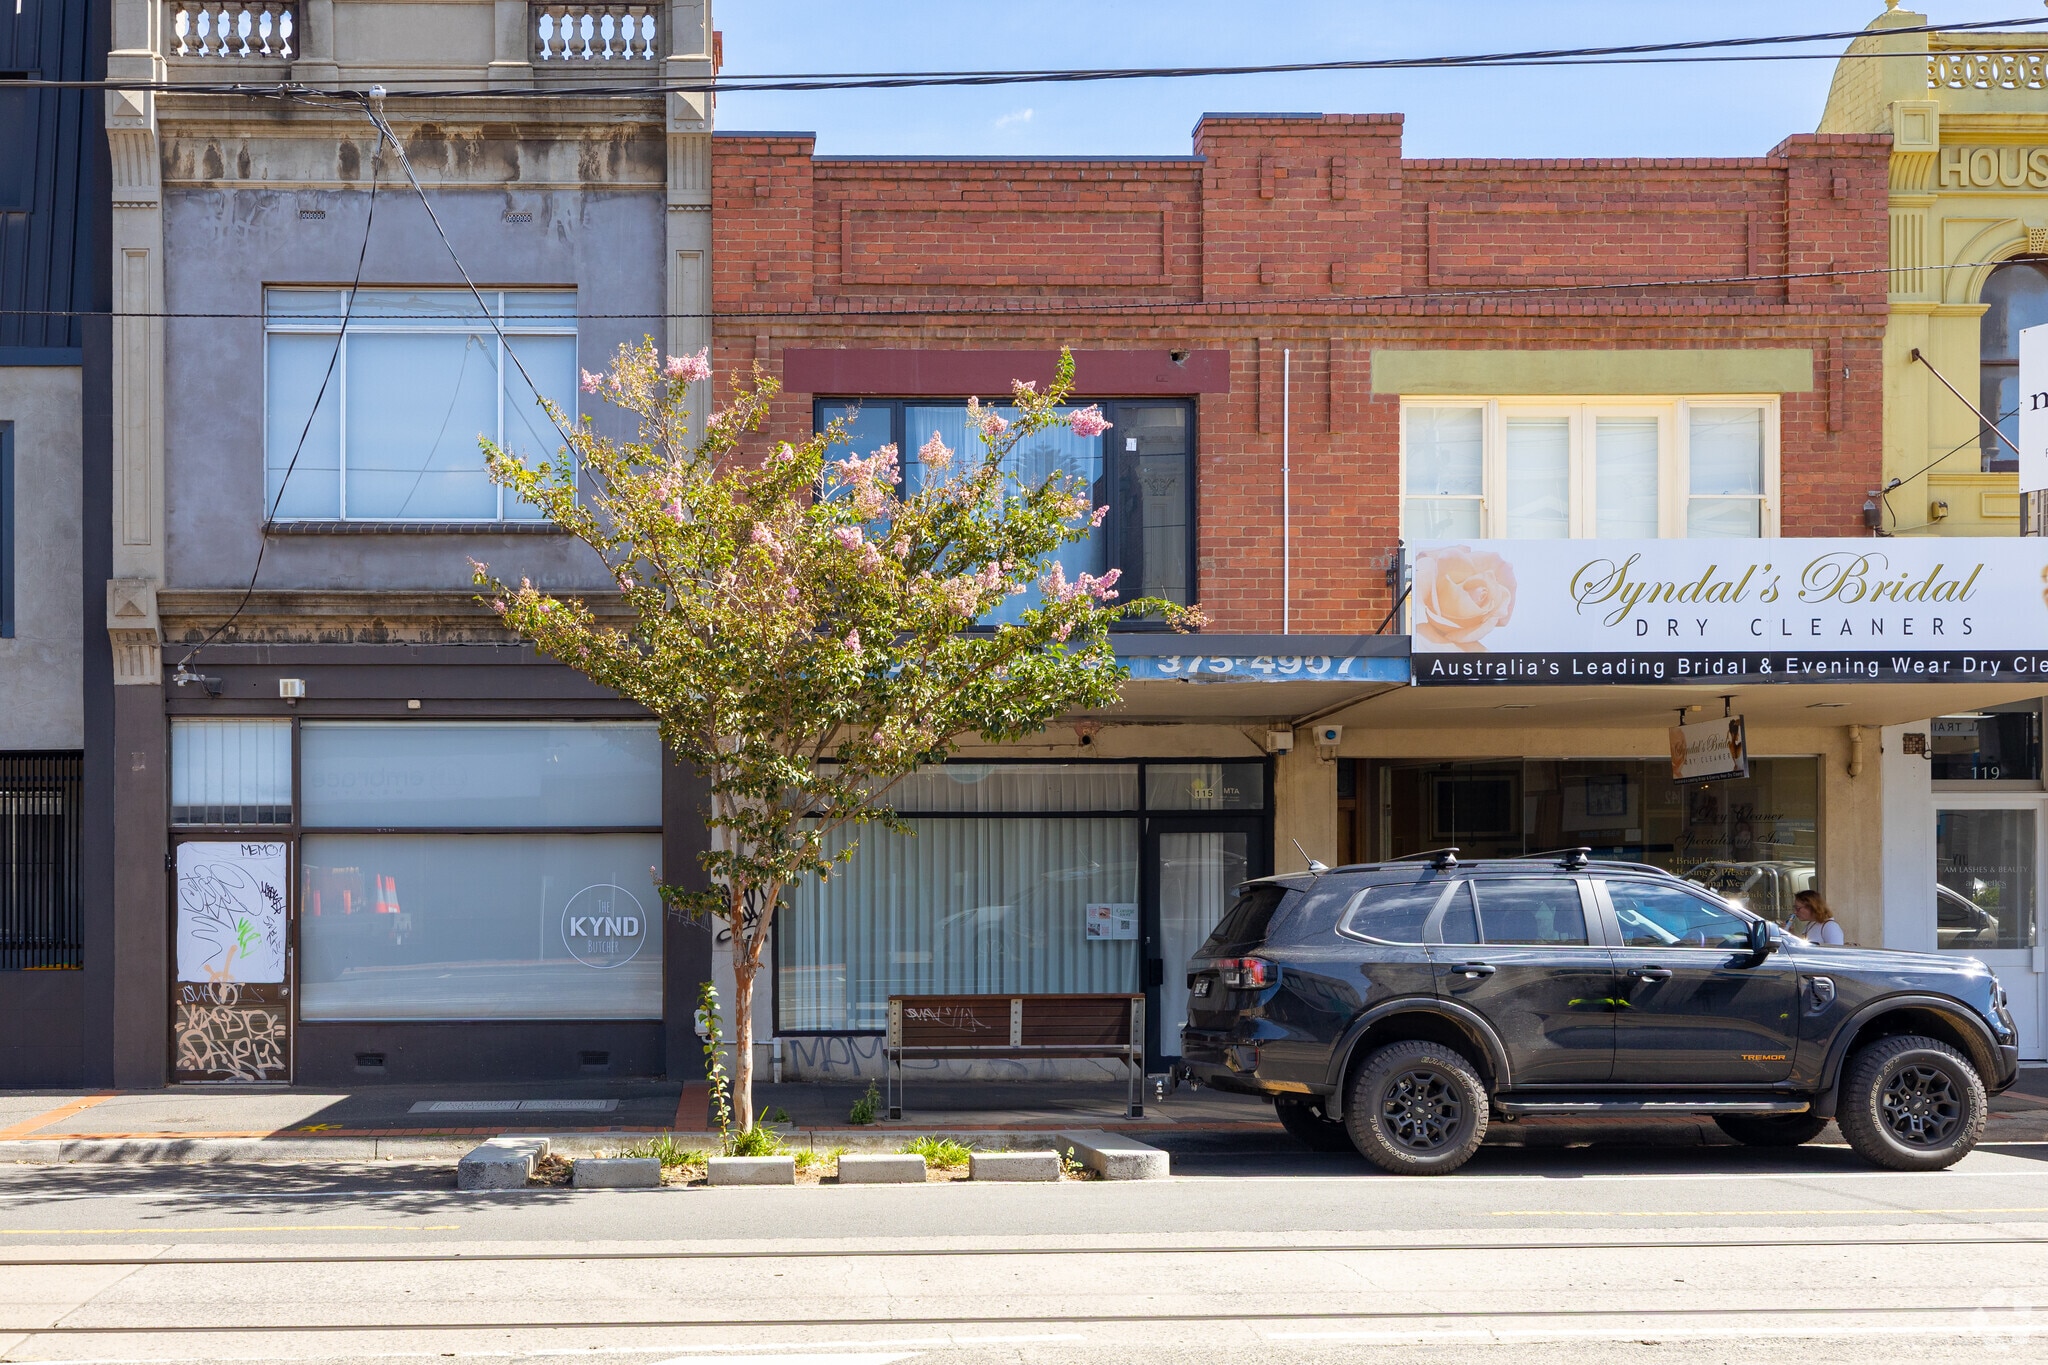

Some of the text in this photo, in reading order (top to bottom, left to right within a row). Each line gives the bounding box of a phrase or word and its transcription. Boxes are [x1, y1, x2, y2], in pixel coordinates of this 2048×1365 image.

[1569, 551, 1985, 628] Syndal's Bridal
[1636, 617, 1974, 637] DRY CLEANERS
[1430, 658, 1560, 676] Australia's
[1572, 658, 1664, 679] Leading
[1678, 657, 1746, 675] Bridal
[1759, 657, 1773, 675] &
[1786, 657, 1879, 678] Evening
[1891, 657, 1951, 674] Wear
[1963, 656, 2001, 677] Dry
[1971, 766, 2000, 780] 119
[1196, 789, 1214, 798] 115
[1676, 856, 1702, 866] Bridal
[598, 899, 611, 914] THE
[570, 916, 639, 937] KYND
[587, 939, 620, 954] BUTCHER
[1951, 1086, 1977, 1150] GENERAL
[1369, 1114, 1418, 1164] GENERAL
